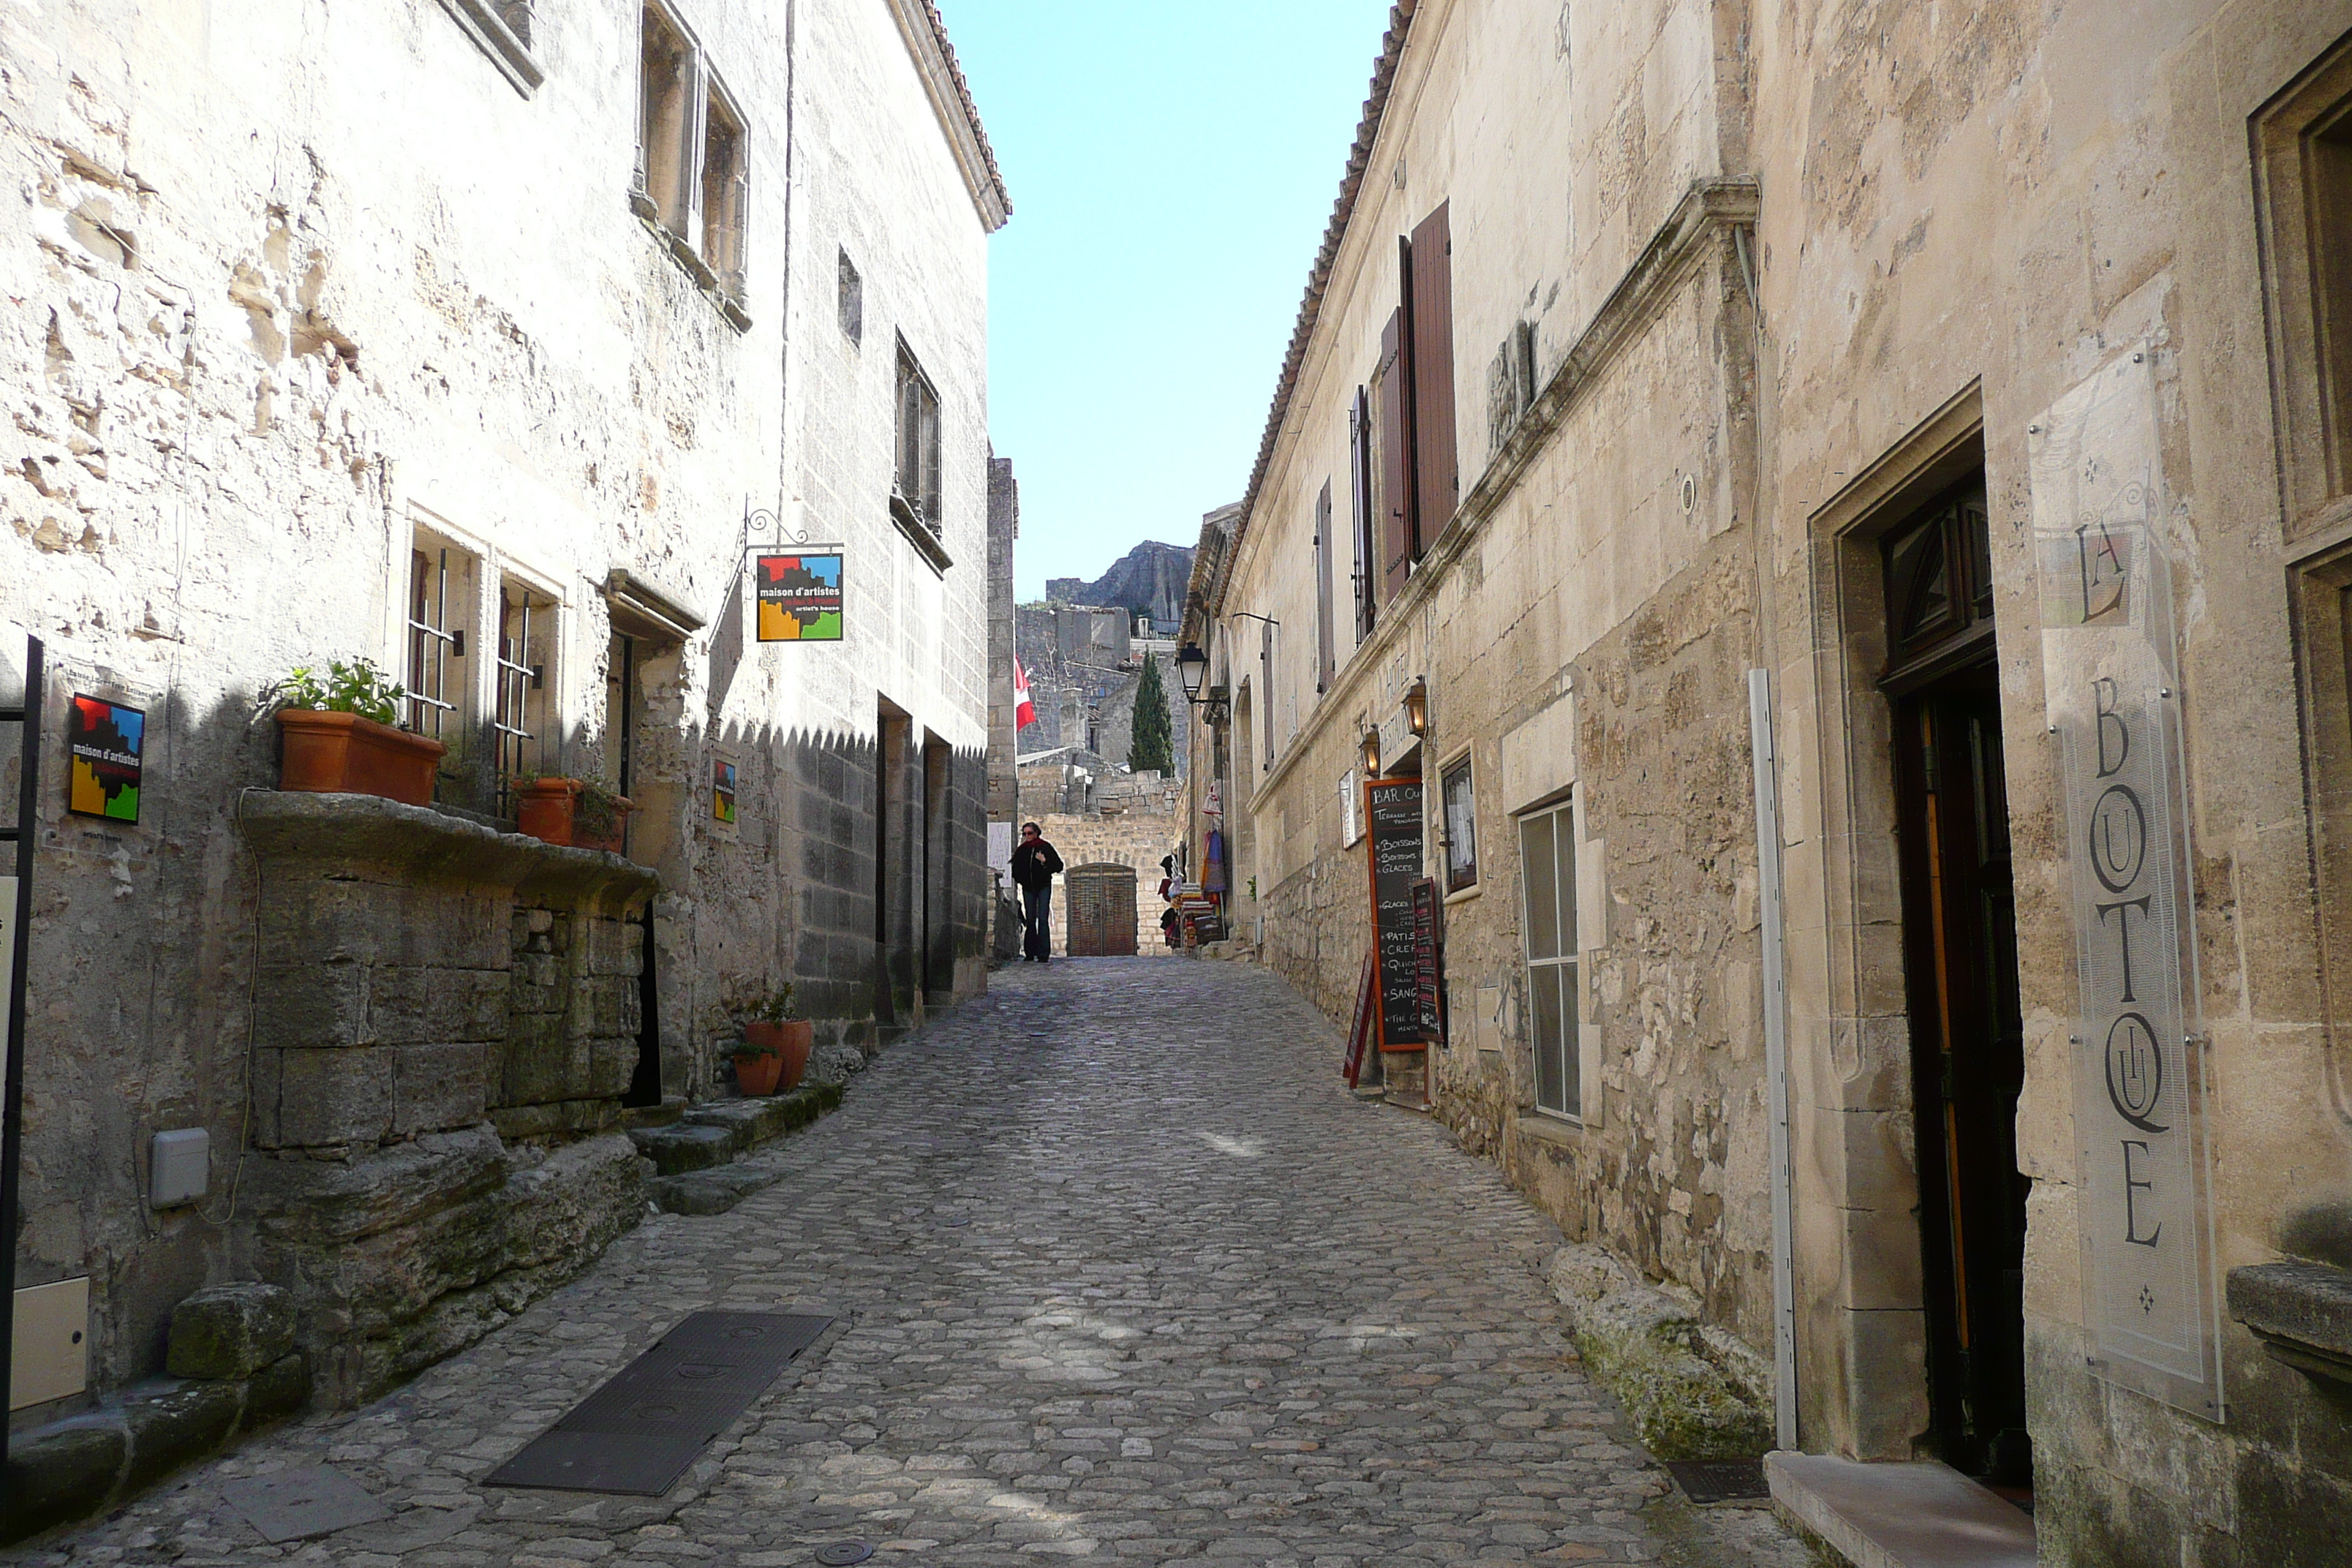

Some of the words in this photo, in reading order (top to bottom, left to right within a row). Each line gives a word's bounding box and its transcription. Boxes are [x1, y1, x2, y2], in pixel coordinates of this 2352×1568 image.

[760, 587, 794, 597] maison
[796, 586, 840, 596] d'artistes
[1386, 652, 1410, 701] HOTEL
[73, 743, 102, 758] maison
[103, 748, 140, 767] d'artistes
[1373, 788, 1401, 804] BAR
[1381, 838, 1422, 851] BOISSONS
[1382, 864, 1414, 874] GLACES
[1382, 900, 1409, 910] GLACES
[1386, 932, 1415, 941] PATIS
[1390, 987, 1417, 1001] SANG
